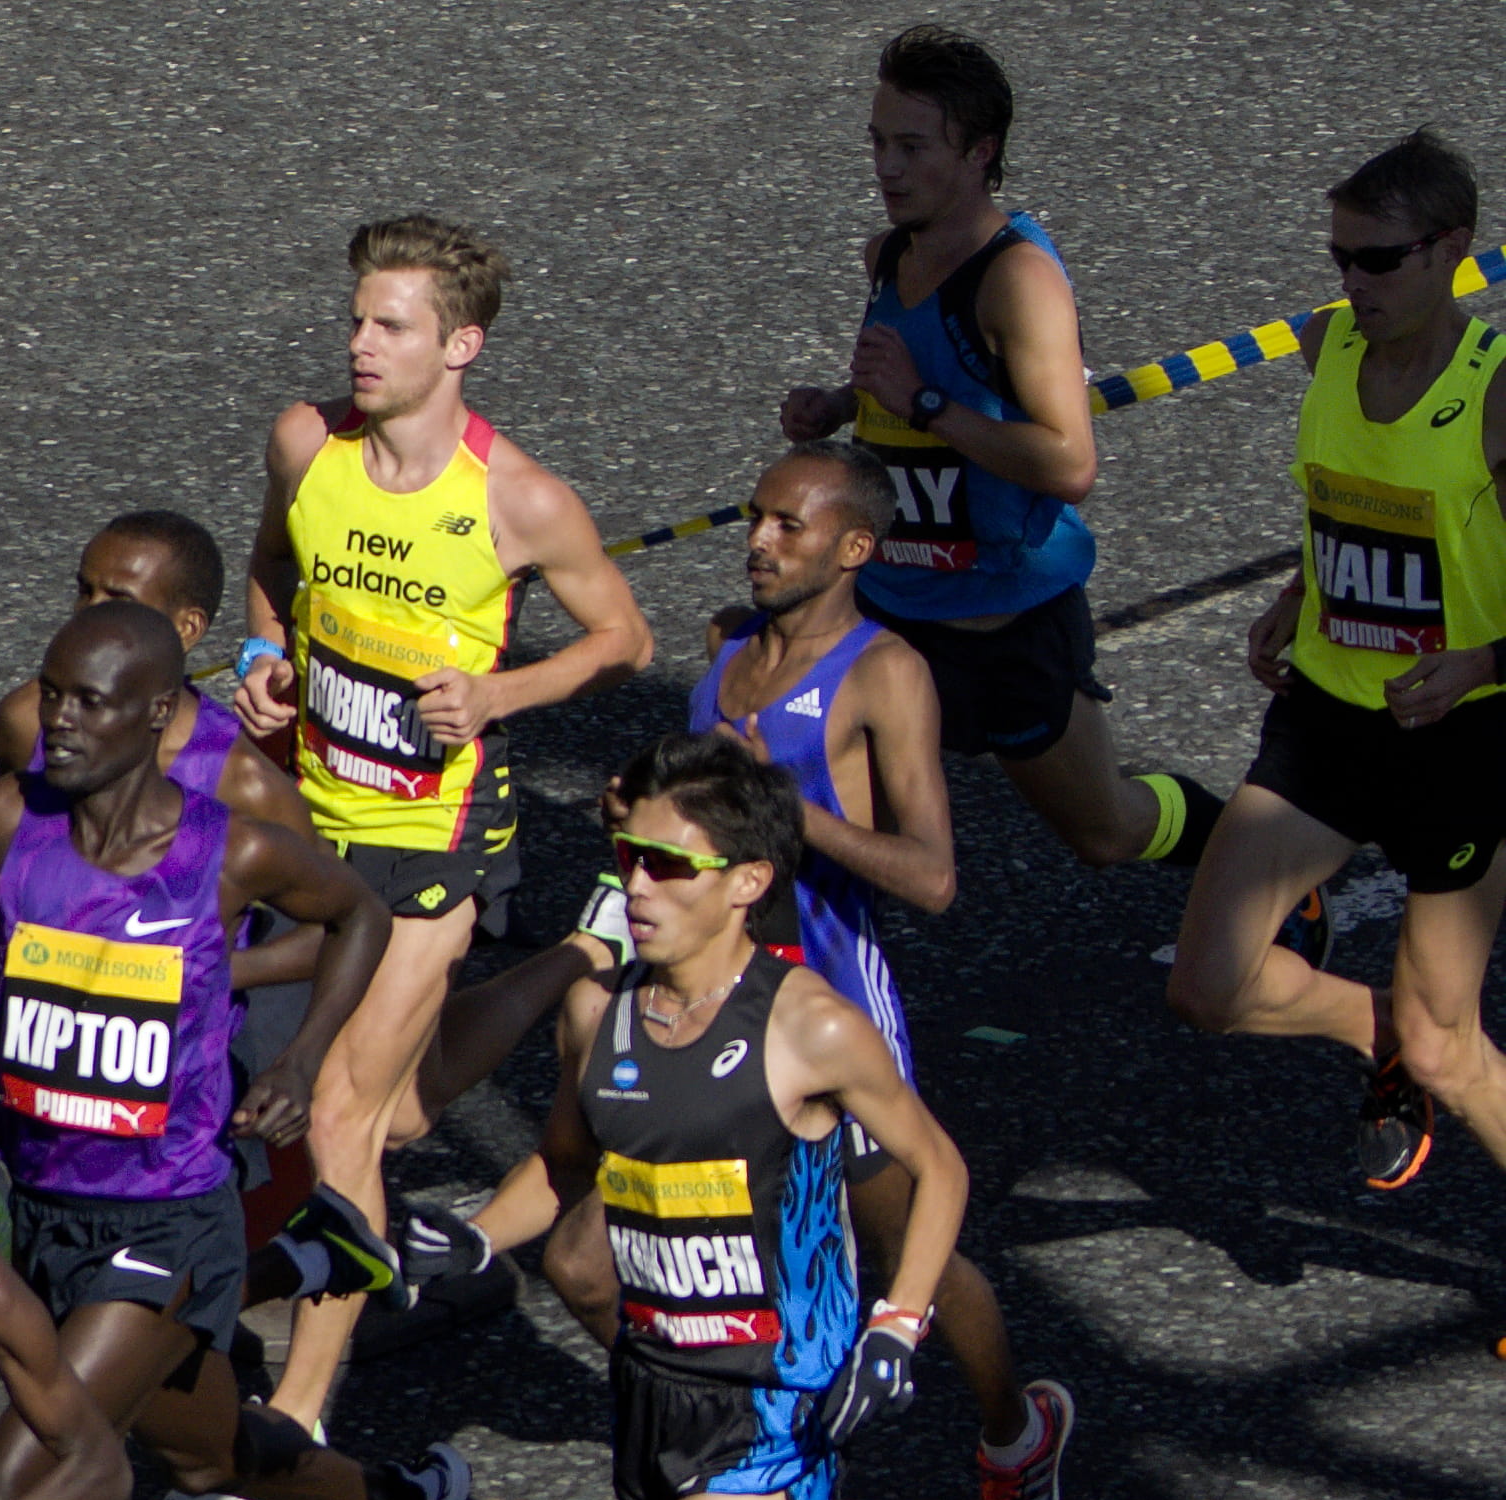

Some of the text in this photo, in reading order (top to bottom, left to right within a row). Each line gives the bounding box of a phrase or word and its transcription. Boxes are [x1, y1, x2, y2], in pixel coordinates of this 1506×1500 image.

[885, 465, 961, 524] AY
[1331, 489, 1424, 521] MORRISONS
[346, 528, 414, 562] new
[312, 554, 447, 608] balance
[1313, 530, 1441, 610] HALL
[340, 626, 446, 668] MORRISONS
[1329, 616, 1396, 651] PUMA
[326, 745, 392, 792] PUMA
[55, 949, 168, 983] MORRISONS
[2, 995, 171, 1088] KIPTOO
[34, 1087, 113, 1131] PUMA
[608, 1224, 765, 1298] KIKUCHI
